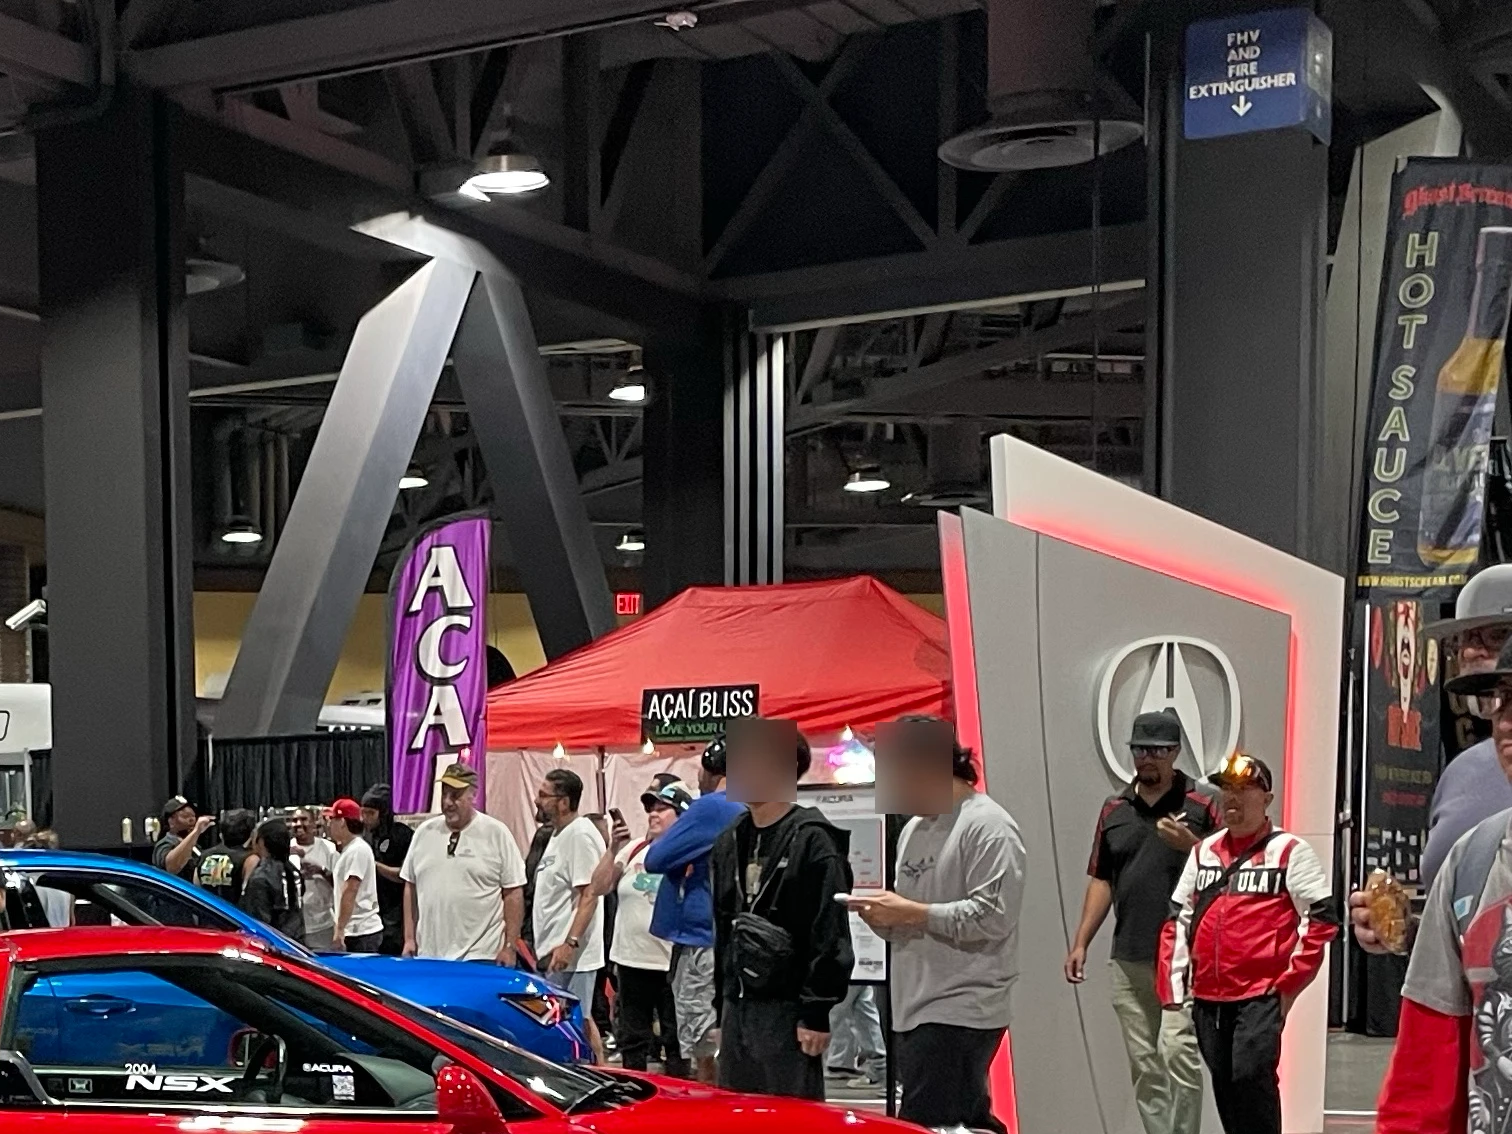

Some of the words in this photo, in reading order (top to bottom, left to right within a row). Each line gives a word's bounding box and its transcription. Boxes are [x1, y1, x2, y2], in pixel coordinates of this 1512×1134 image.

[1227, 29, 1260, 46] FHV
[1227, 45, 1261, 62] AND
[1228, 61, 1258, 78] FIRE
[1189, 72, 1296, 99] EXTINGUISHER
[1398, 231, 1439, 349] HOT
[1367, 364, 1417, 564] SAUCE
[616, 594, 640, 614] EXIT
[648, 688, 696, 726] AÇAÍ
[699, 689, 754, 717] BLISS
[656, 723, 686, 735] LOVE
[686, 722, 717, 734] YOUR
[125, 1063, 157, 1076] 2004
[311, 1064, 354, 1074] ACURA
[125, 1075, 236, 1093] NSX
